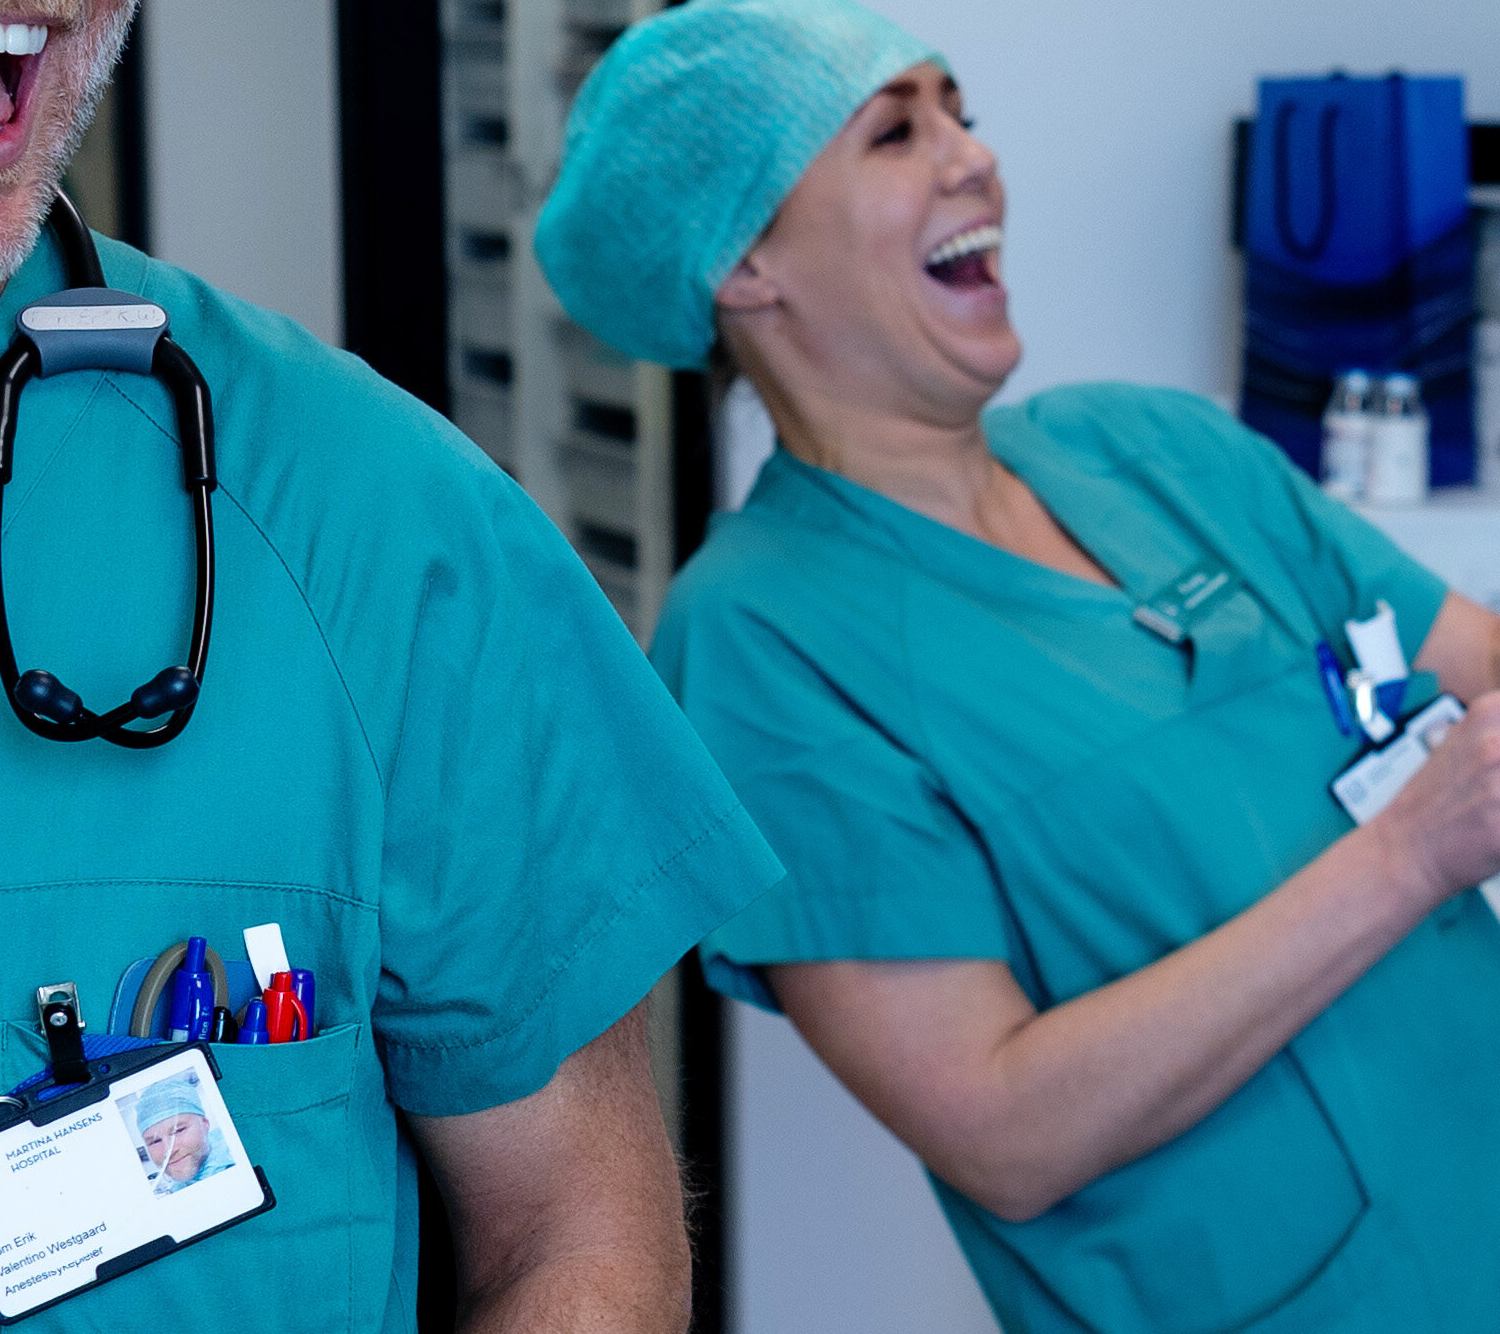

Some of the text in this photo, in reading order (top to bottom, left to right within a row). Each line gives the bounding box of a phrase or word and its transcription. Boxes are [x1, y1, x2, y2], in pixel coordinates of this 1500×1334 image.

[5, 1112, 103, 1161] MARTINA HANSENS
[10, 1147, 61, 1173] HOSPITAL
[14, 1231, 37, 1248] Erik
[46, 1221, 107, 1255] Westgaard
